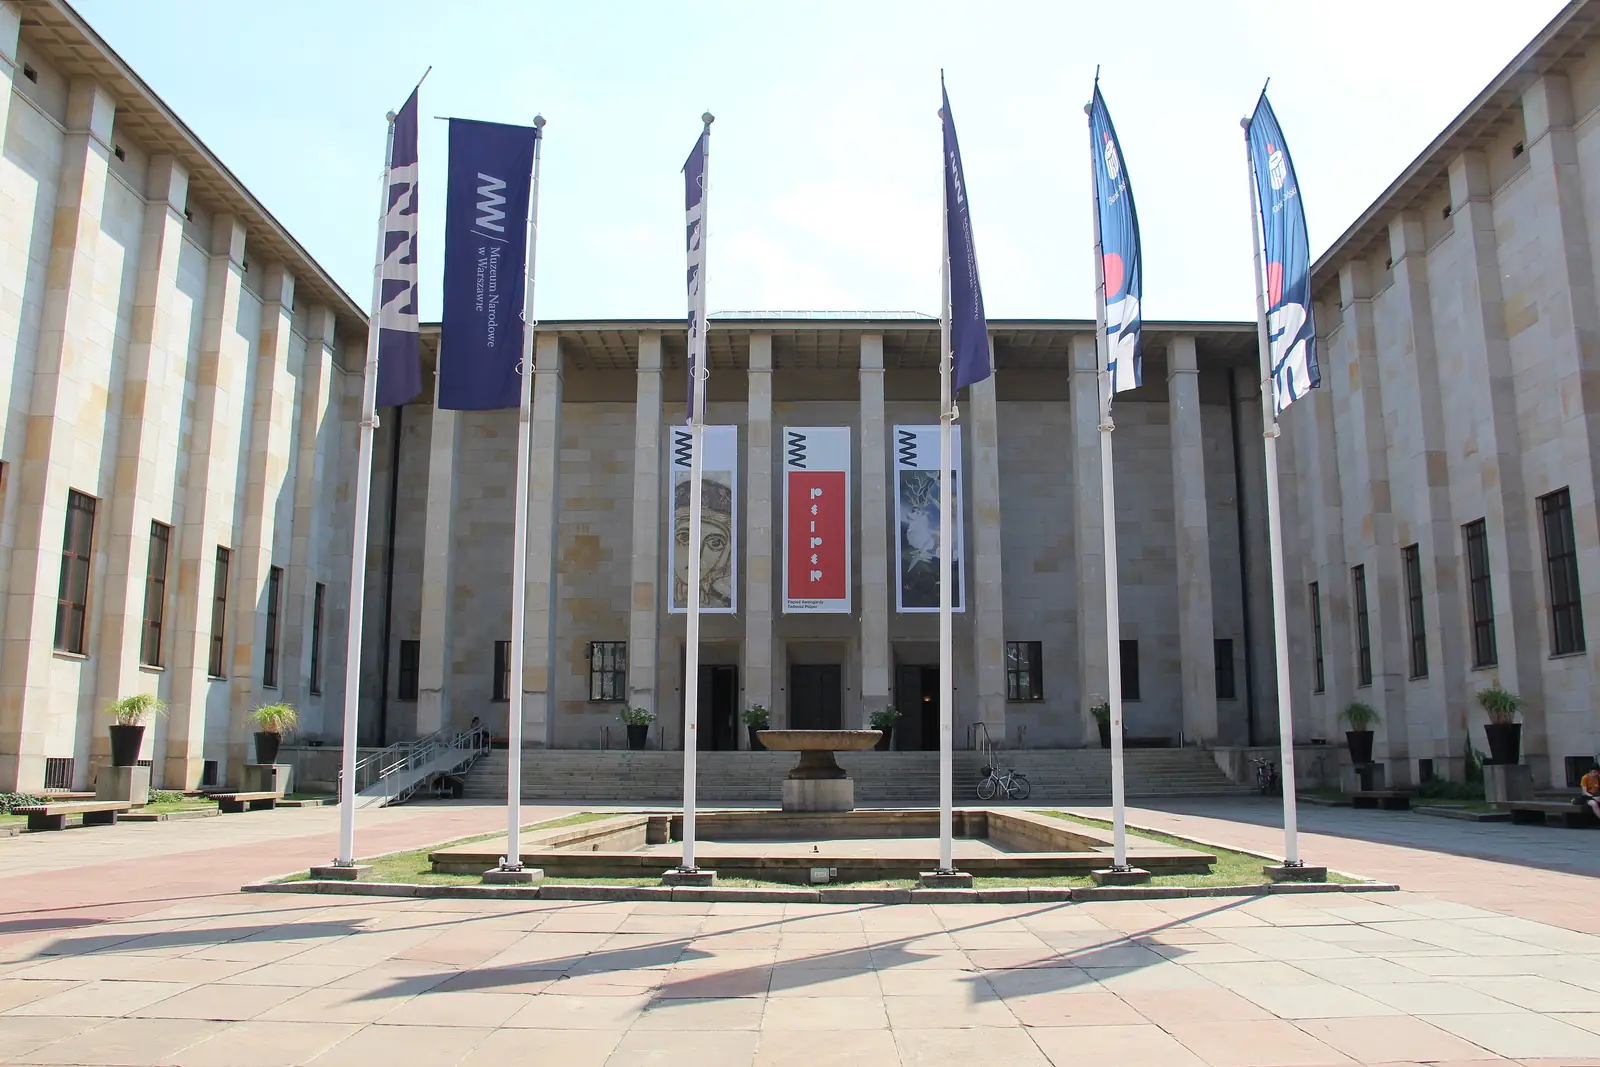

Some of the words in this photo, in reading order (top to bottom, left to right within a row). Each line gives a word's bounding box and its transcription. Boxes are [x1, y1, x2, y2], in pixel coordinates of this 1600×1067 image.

[475, 257, 488, 312] Warszawie
[489, 246, 501, 292] Muzeum
[487, 293, 500, 348] Narodowe
